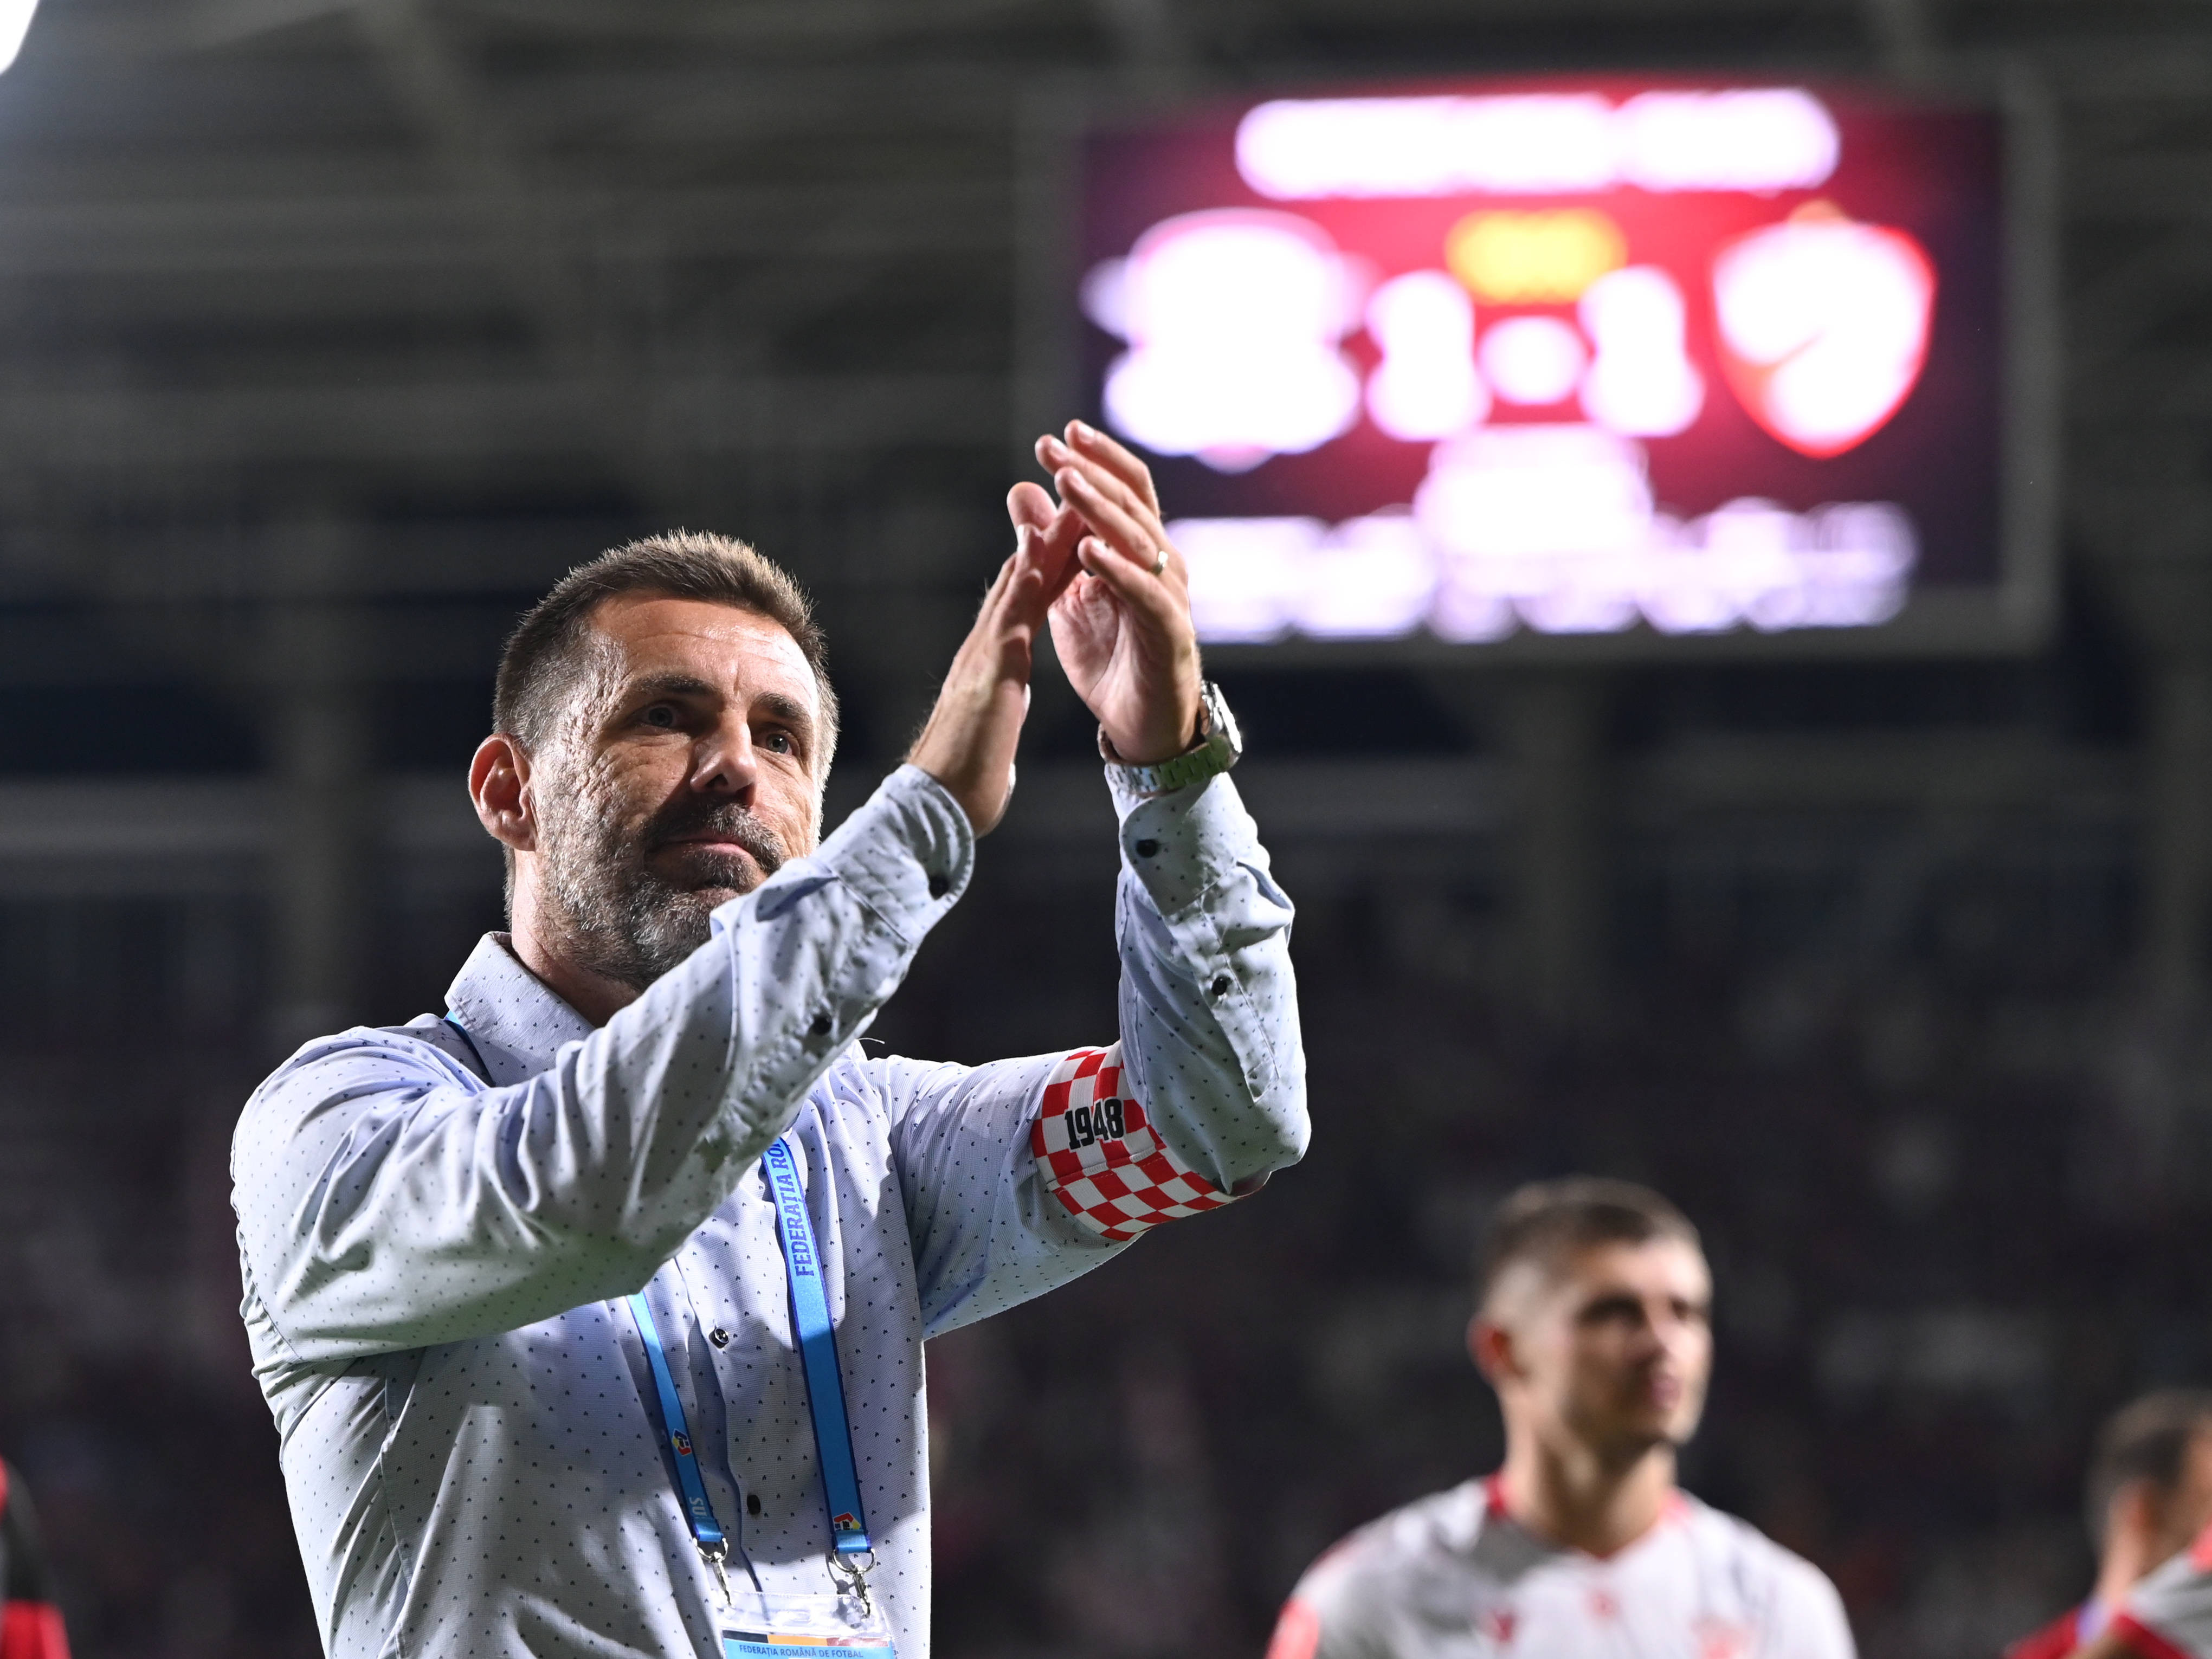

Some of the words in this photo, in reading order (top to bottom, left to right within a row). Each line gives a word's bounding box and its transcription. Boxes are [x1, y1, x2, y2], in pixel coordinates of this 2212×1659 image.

[1065, 1099, 1124, 1150] 1948
[776, 1174, 814, 1277] FEDERAȚIA
[688, 1497, 707, 1519] SU
[739, 1644, 778, 1657] FEDERAȚIA
[780, 1647, 816, 1657] ROMÂNĂ
[832, 1650, 863, 1658] FOTBAL
